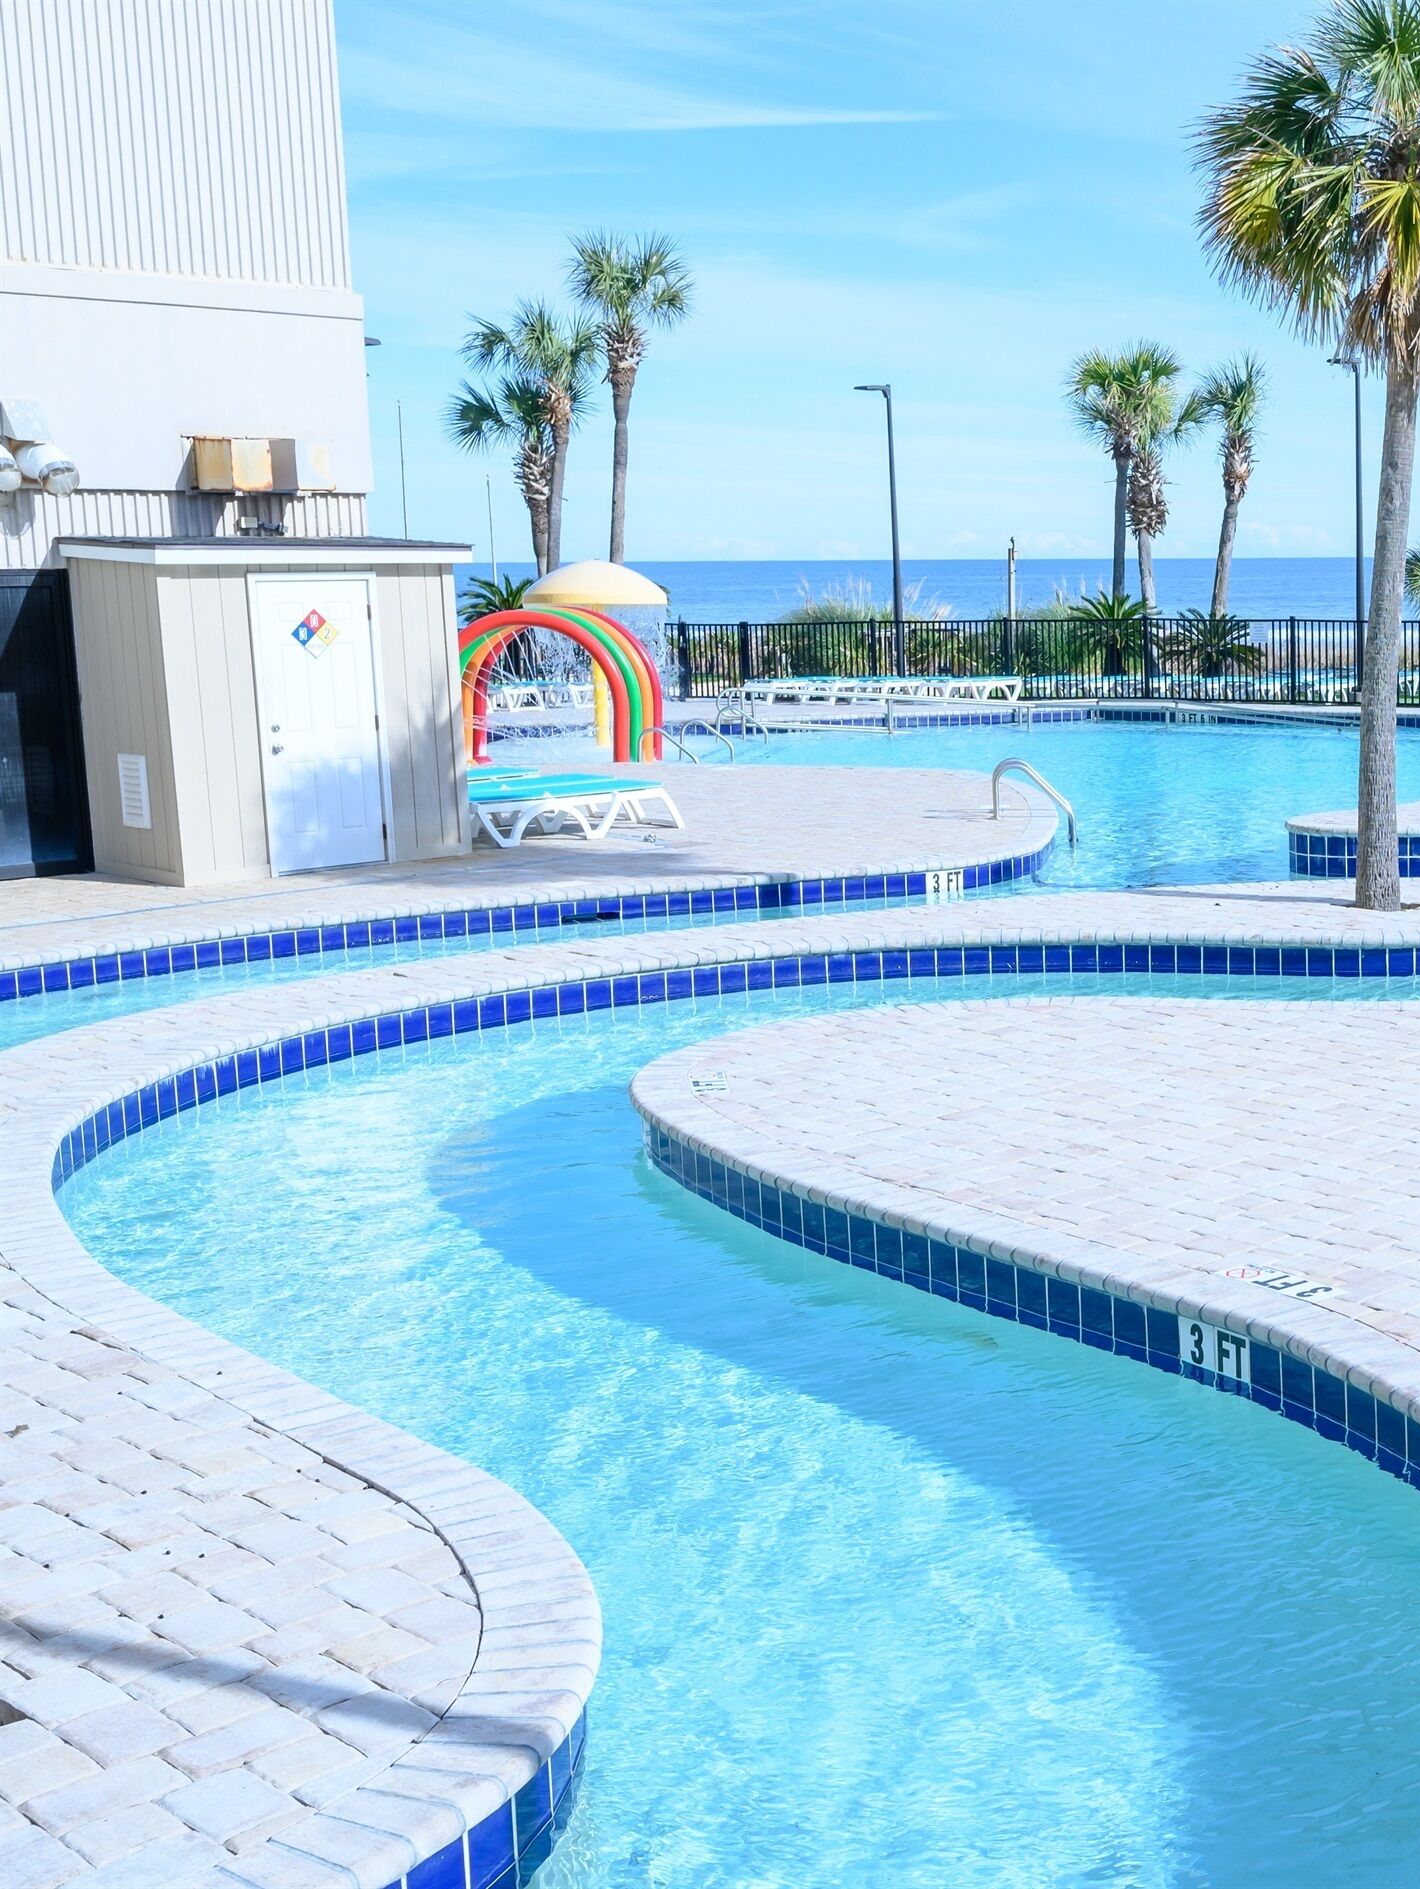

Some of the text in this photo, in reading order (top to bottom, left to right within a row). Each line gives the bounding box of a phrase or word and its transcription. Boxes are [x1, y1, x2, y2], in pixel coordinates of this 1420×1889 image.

[324, 628, 331, 639] 2
[1181, 713, 1186, 723] 3
[1189, 713, 1197, 723] FT
[1208, 714, 1216, 723] IN
[932, 871, 961, 893] 3 FT
[1251, 1274, 1333, 1298] 3 FT
[1190, 1323, 1247, 1379] 3 FT
